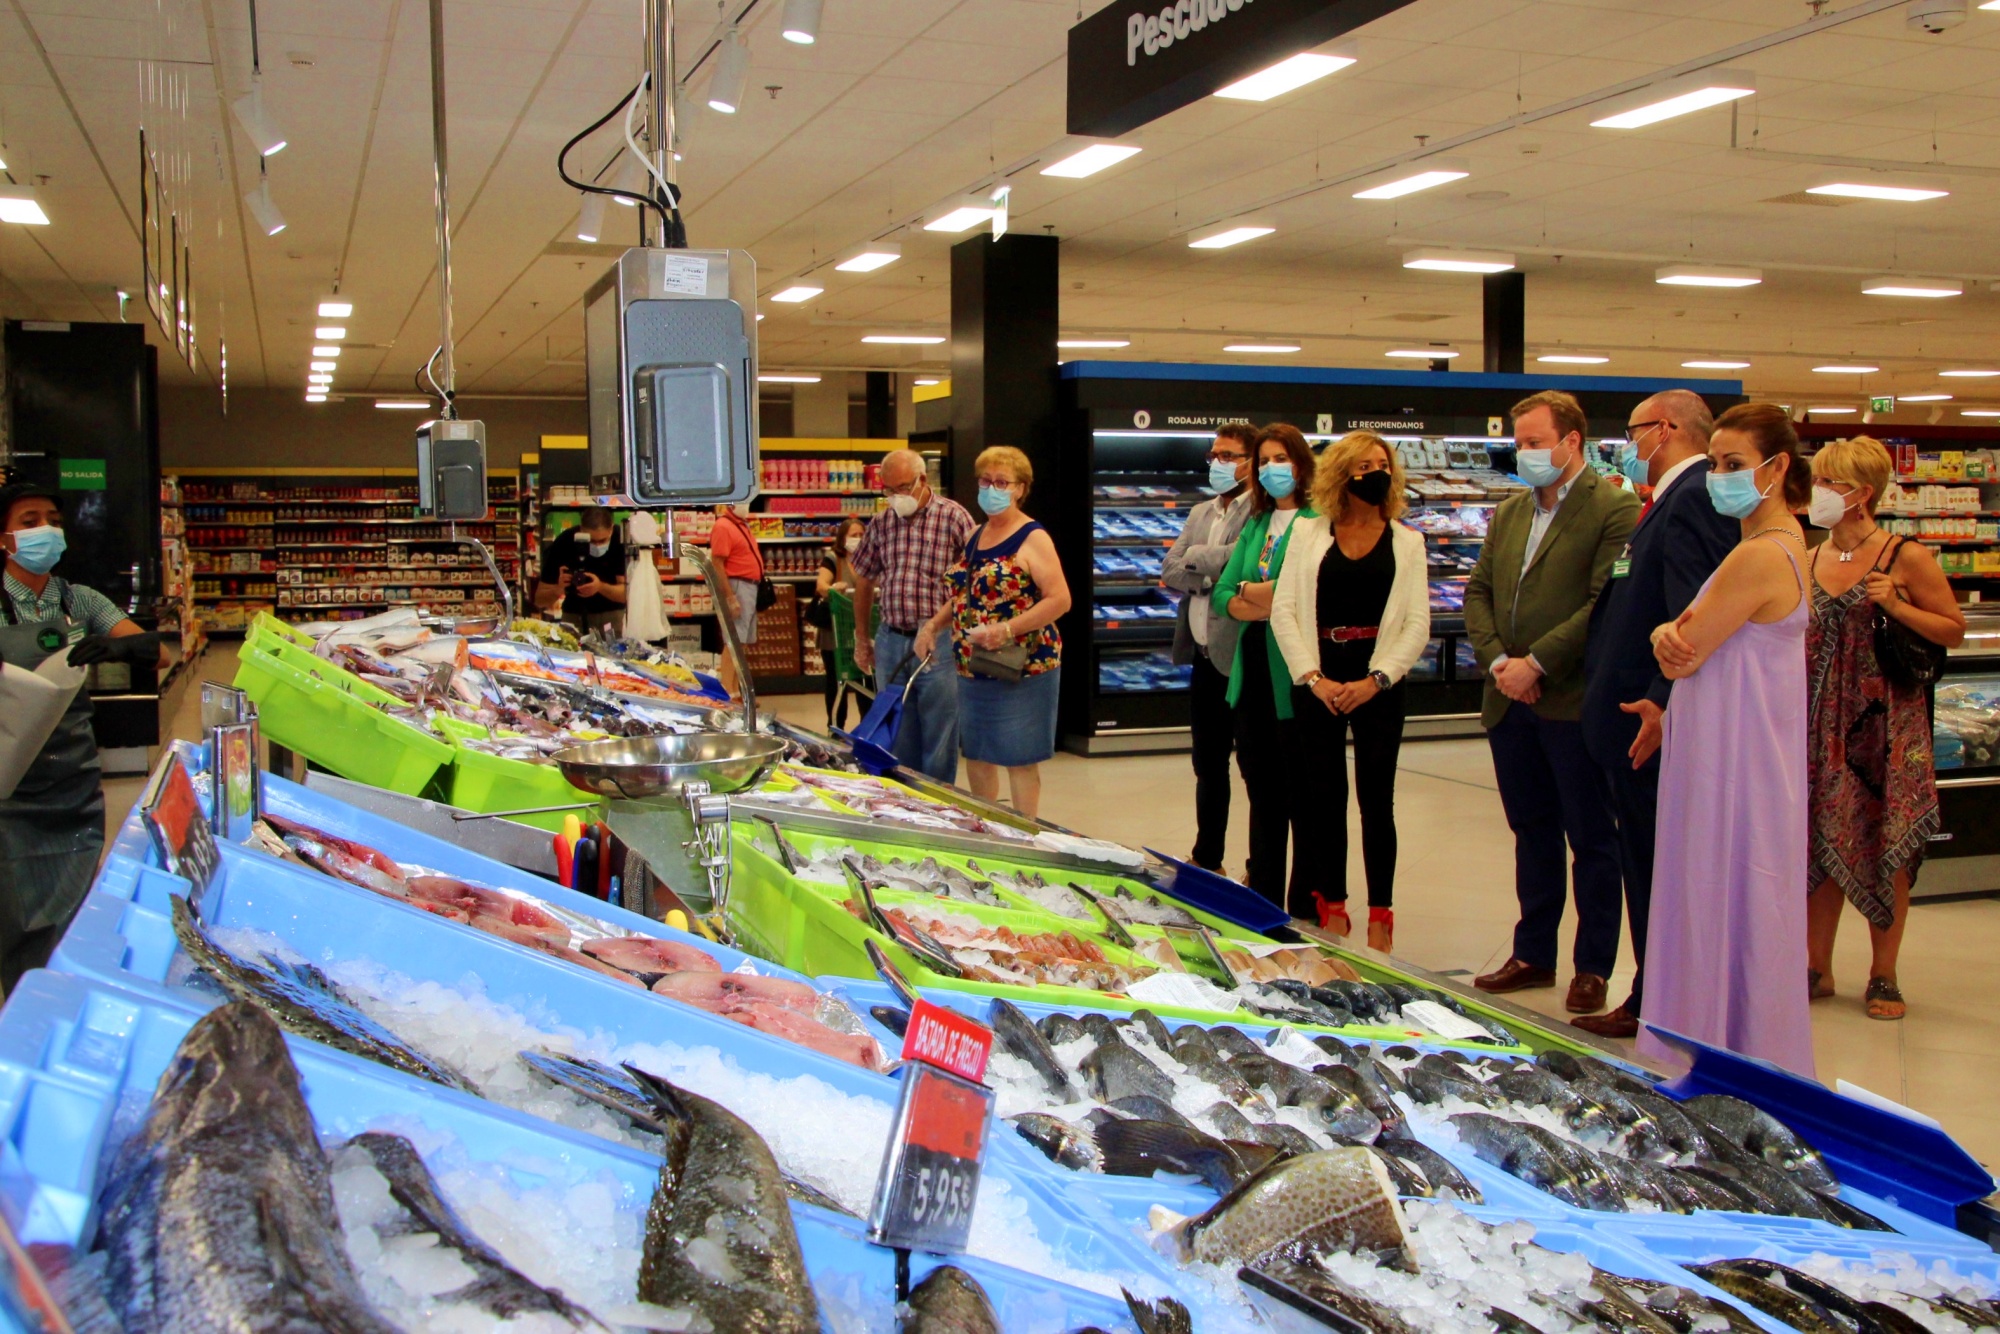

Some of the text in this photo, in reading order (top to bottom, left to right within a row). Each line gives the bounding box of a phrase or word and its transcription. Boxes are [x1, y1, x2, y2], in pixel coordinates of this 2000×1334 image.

[1167, 416, 1250, 426] RODAJAS Y FILETES
[1348, 420, 1425, 430] LE RECOMENDAMOS
[914, 1014, 984, 1077] BAJADA DE PRECIO
